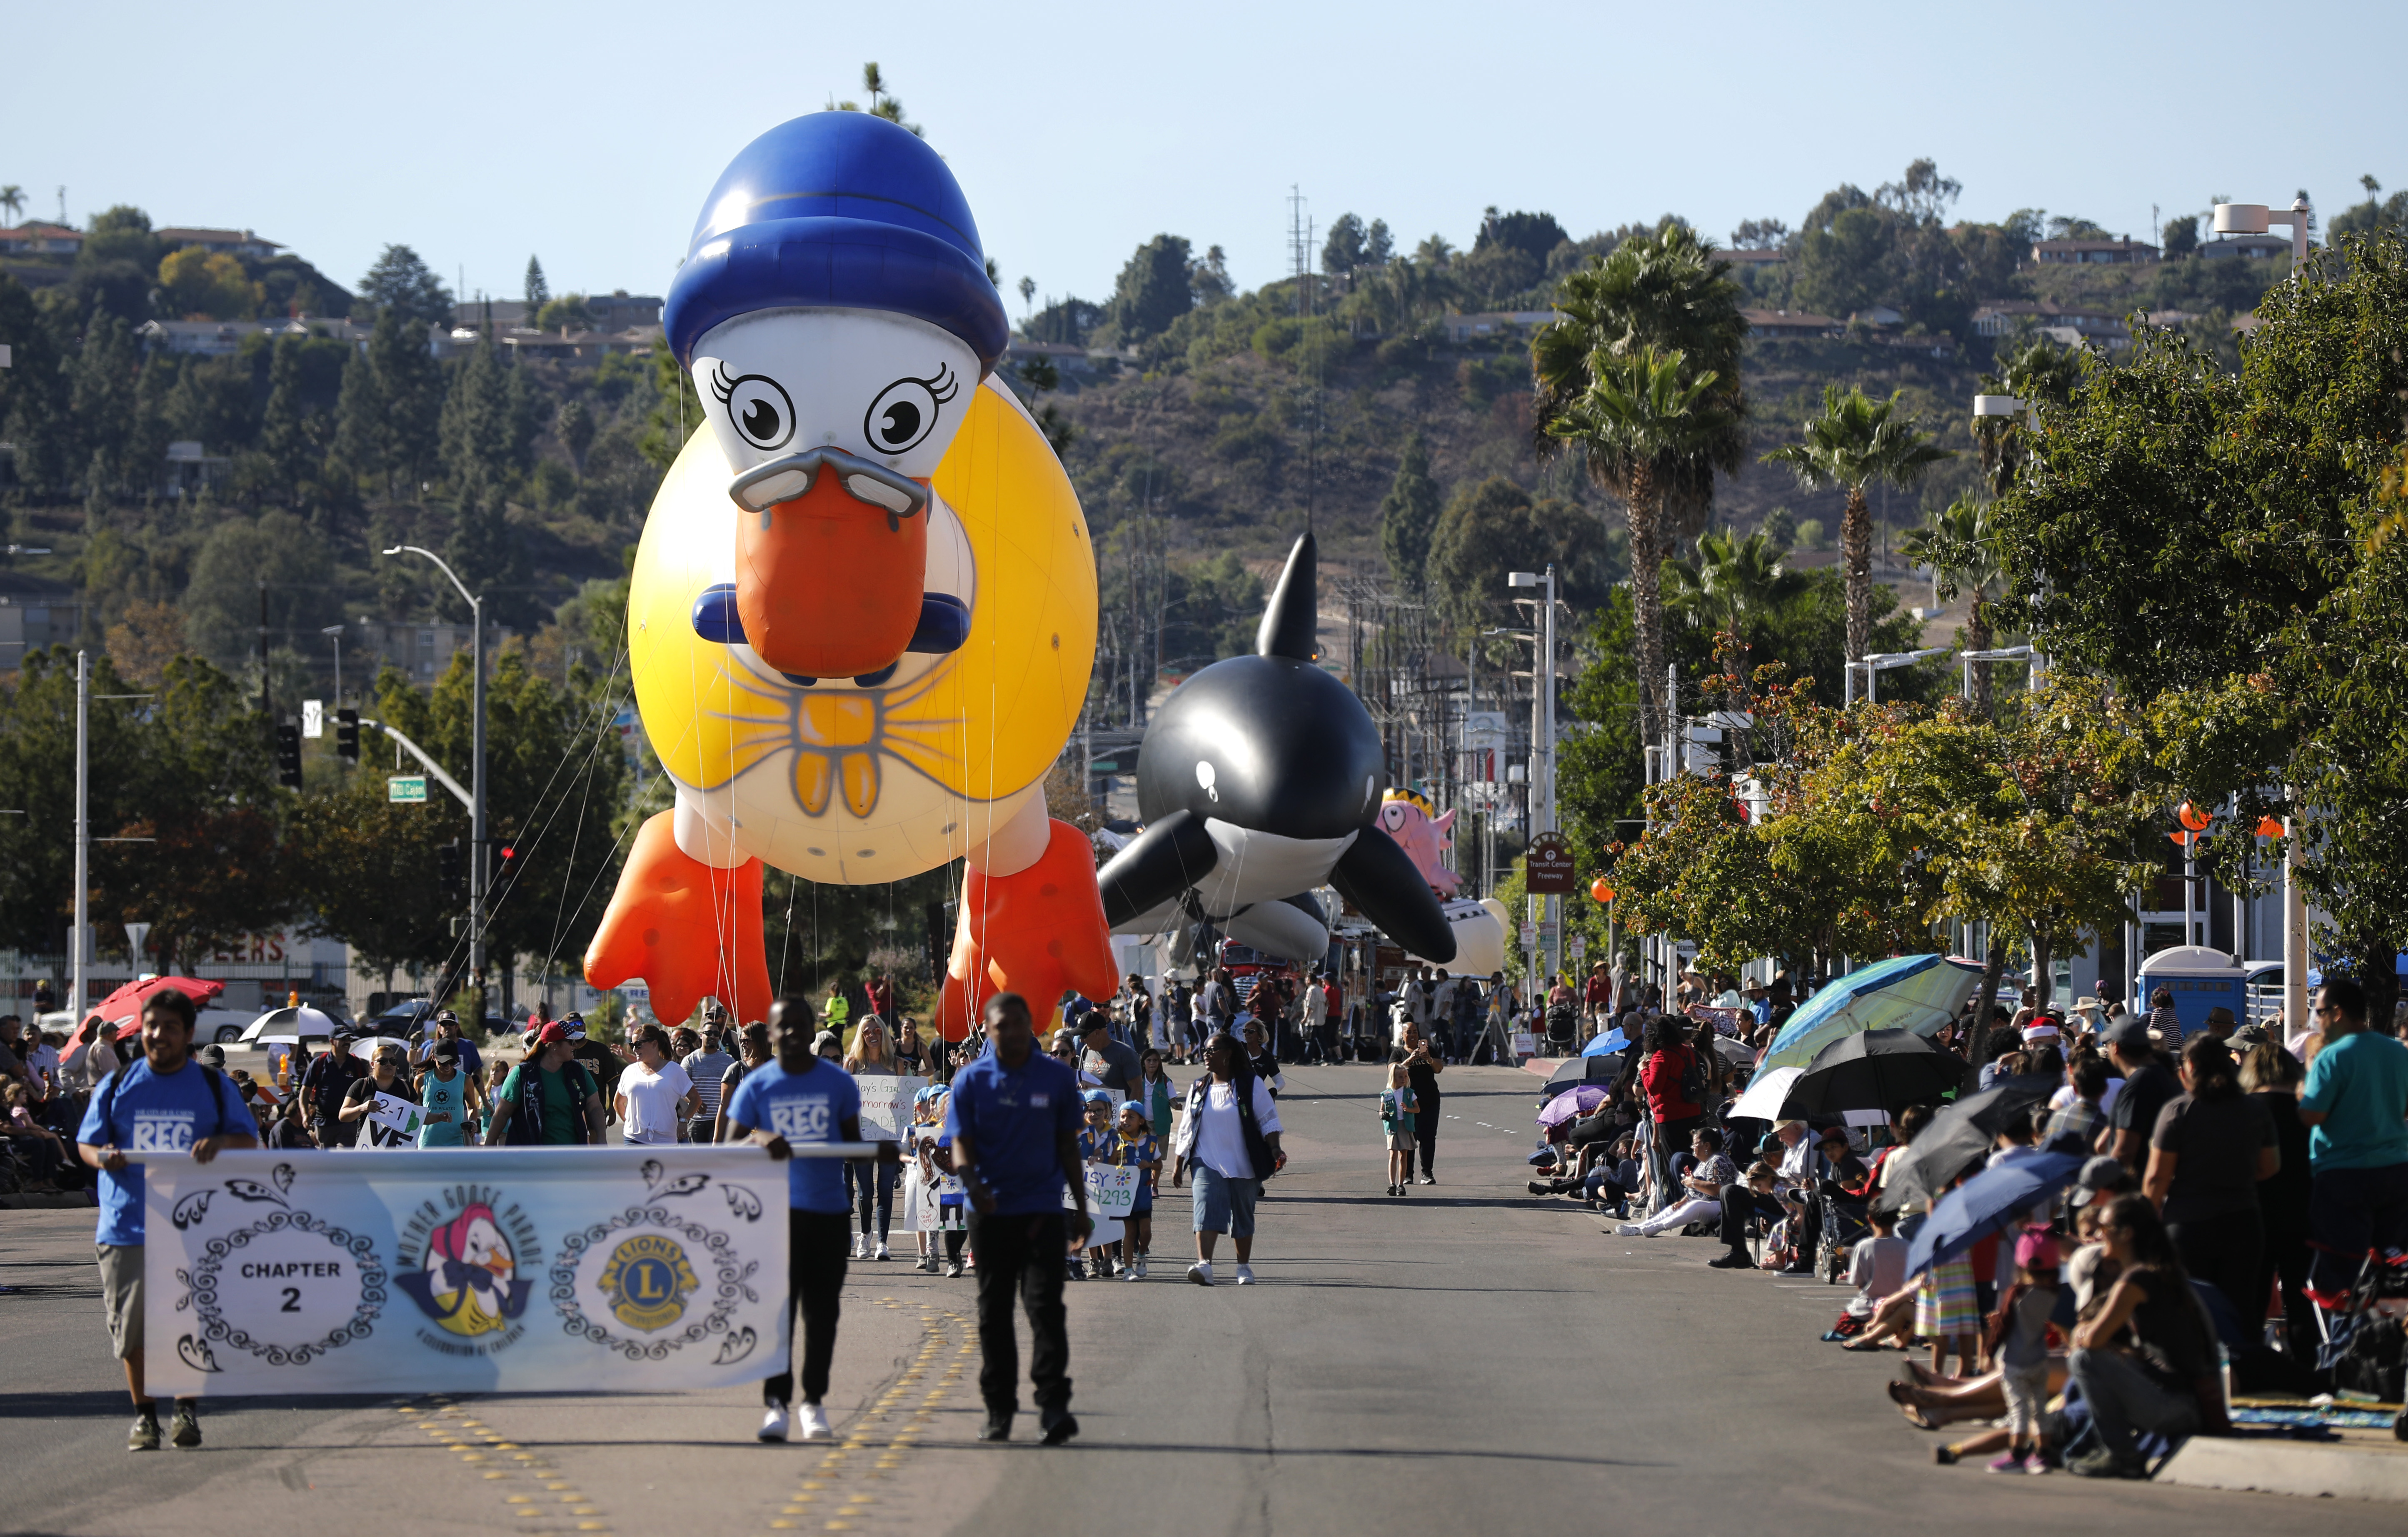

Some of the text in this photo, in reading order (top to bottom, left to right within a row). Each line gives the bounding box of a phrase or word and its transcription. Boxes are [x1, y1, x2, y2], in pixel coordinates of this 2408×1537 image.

[771, 1105, 830, 1135] REC
[133, 1122, 192, 1151] REC
[1094, 1187, 1132, 1206] 4293
[396, 1184, 542, 1268] MOTHER GOOSE PARADE
[620, 1238, 677, 1259] LIONS
[241, 1262, 341, 1279] CHAPTER
[637, 1264, 664, 1299] L
[281, 1288, 300, 1313] 2
[622, 1309, 677, 1324] INTERNATIONAL
